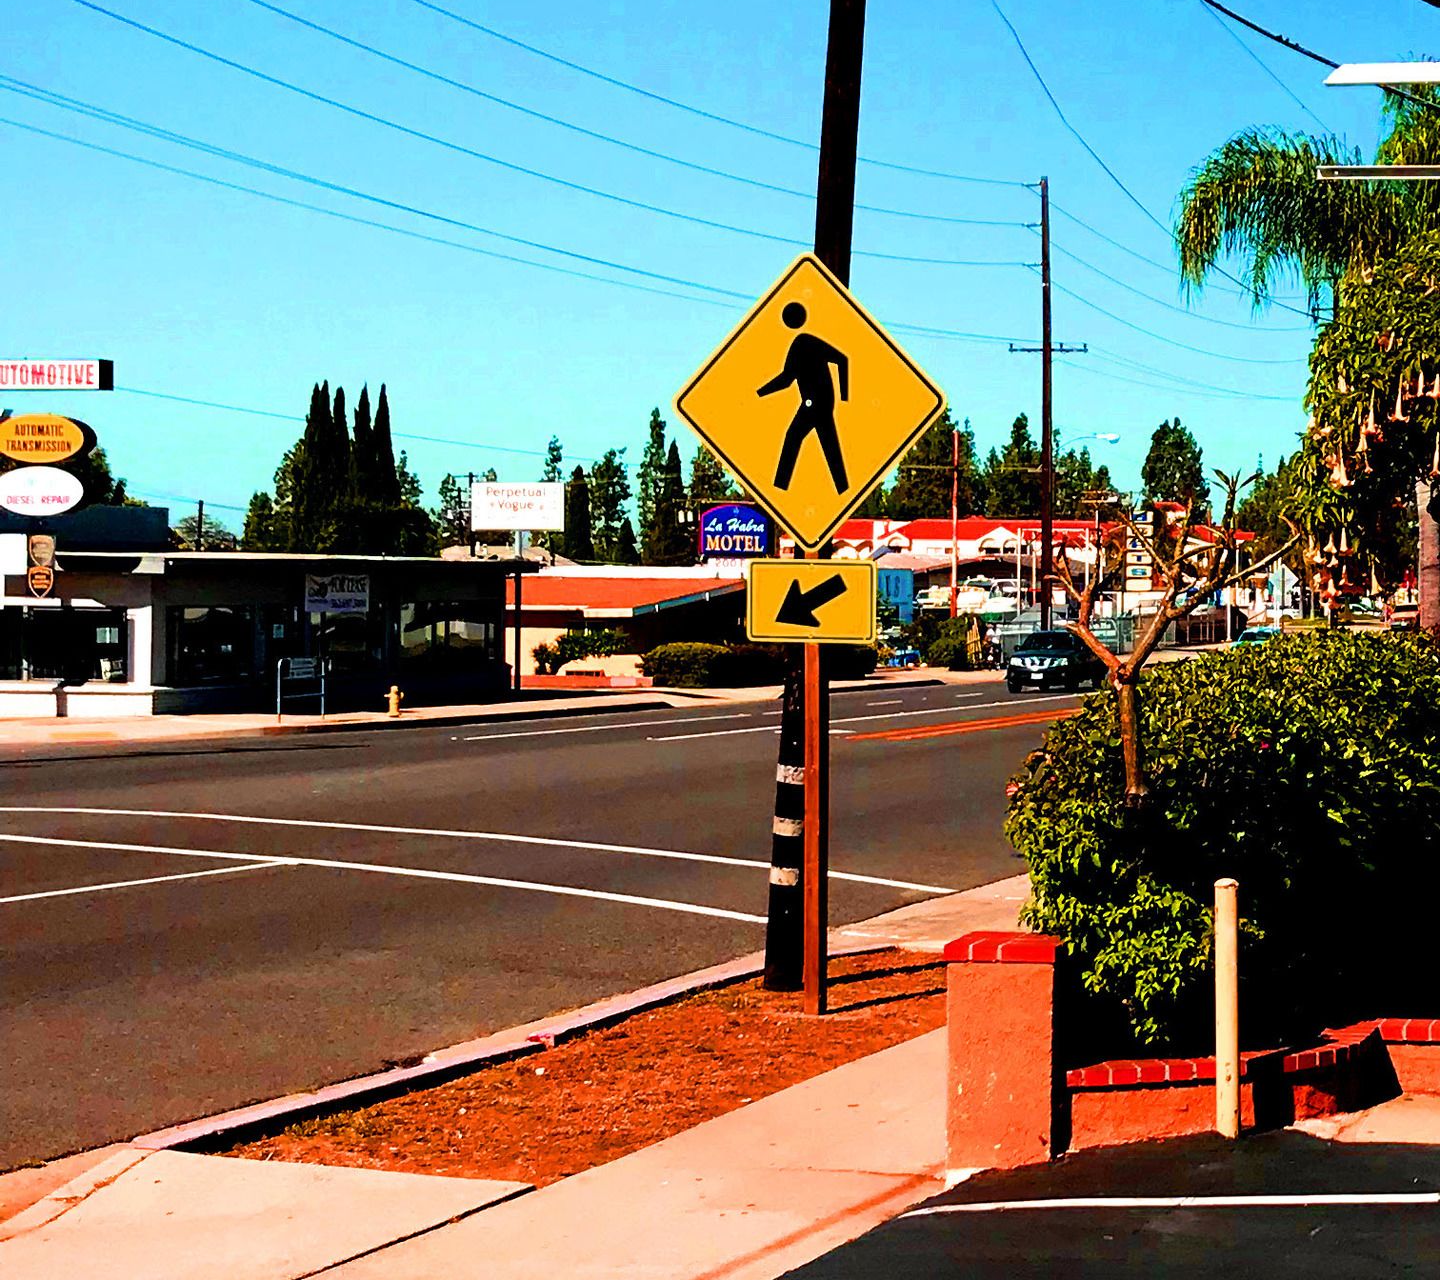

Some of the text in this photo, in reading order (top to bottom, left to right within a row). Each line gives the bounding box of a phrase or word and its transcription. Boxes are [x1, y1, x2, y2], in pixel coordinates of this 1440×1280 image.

[14, 423, 65, 437] AUTOMATIC
[5, 439, 73, 453] TRANSMISSION
[486, 486, 547, 499] Perpetual
[41, 495, 71, 505] REPAIR
[497, 499, 535, 512] Vogue
[704, 517, 766, 533] La Habra
[705, 534, 765, 553] MOTEL
